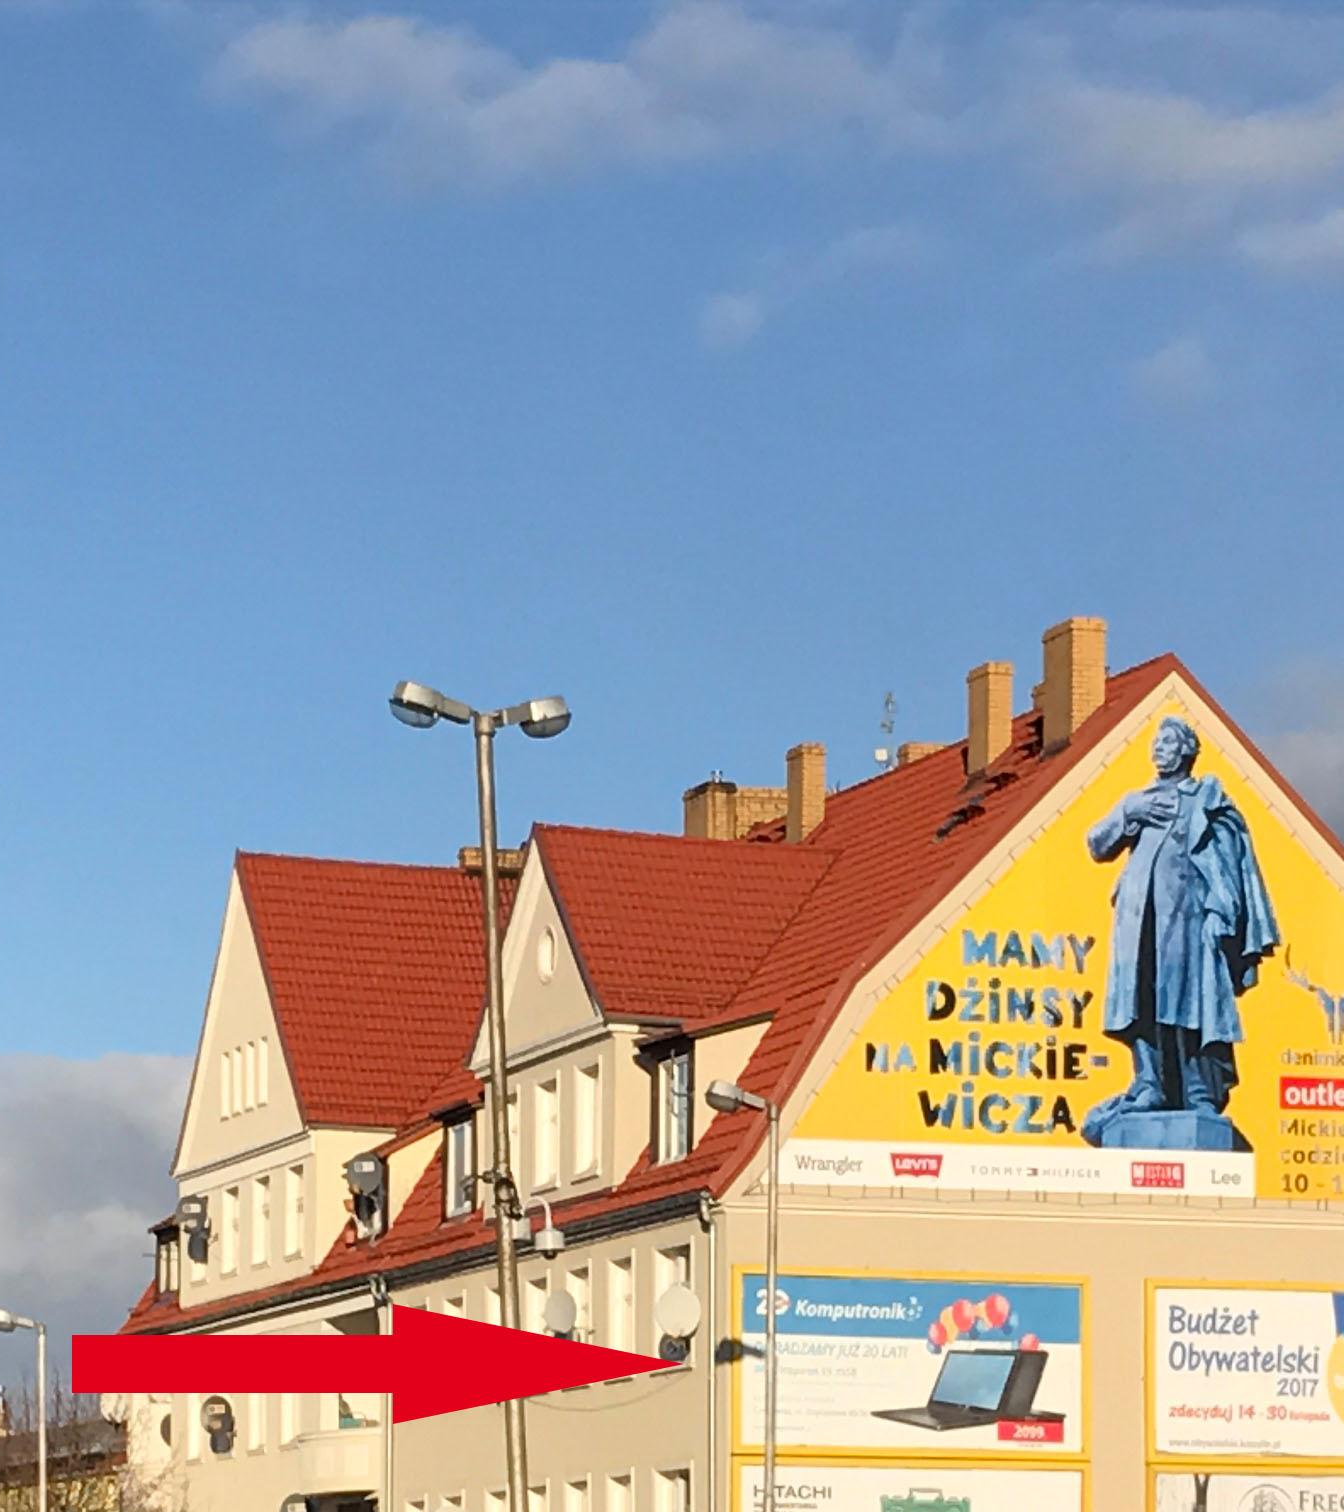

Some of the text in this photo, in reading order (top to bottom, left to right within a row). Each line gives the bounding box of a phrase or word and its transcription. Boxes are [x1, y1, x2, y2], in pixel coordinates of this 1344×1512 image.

[962, 929, 1096, 975] MAMY
[865, 1042, 918, 1074] NA
[794, 1154, 864, 1176] Wrangler
[970, 1164, 1102, 1179] TOMMY HILFIGER
[1210, 1169, 1242, 1186] Lee
[1281, 1173, 1309, 1193] 10
[795, 1299, 907, 1322] Komputronik
[1168, 1304, 1261, 1336] Budżet
[1168, 1340, 1321, 1377] Obywatelski
[1276, 1377, 1320, 1398] 2017
[1168, 1404, 1233, 1424] zdecyduj
[1238, 1404, 1255, 1419] 14
[1266, 1405, 1288, 1420] 30
[753, 1484, 832, 1500] HTACHI
